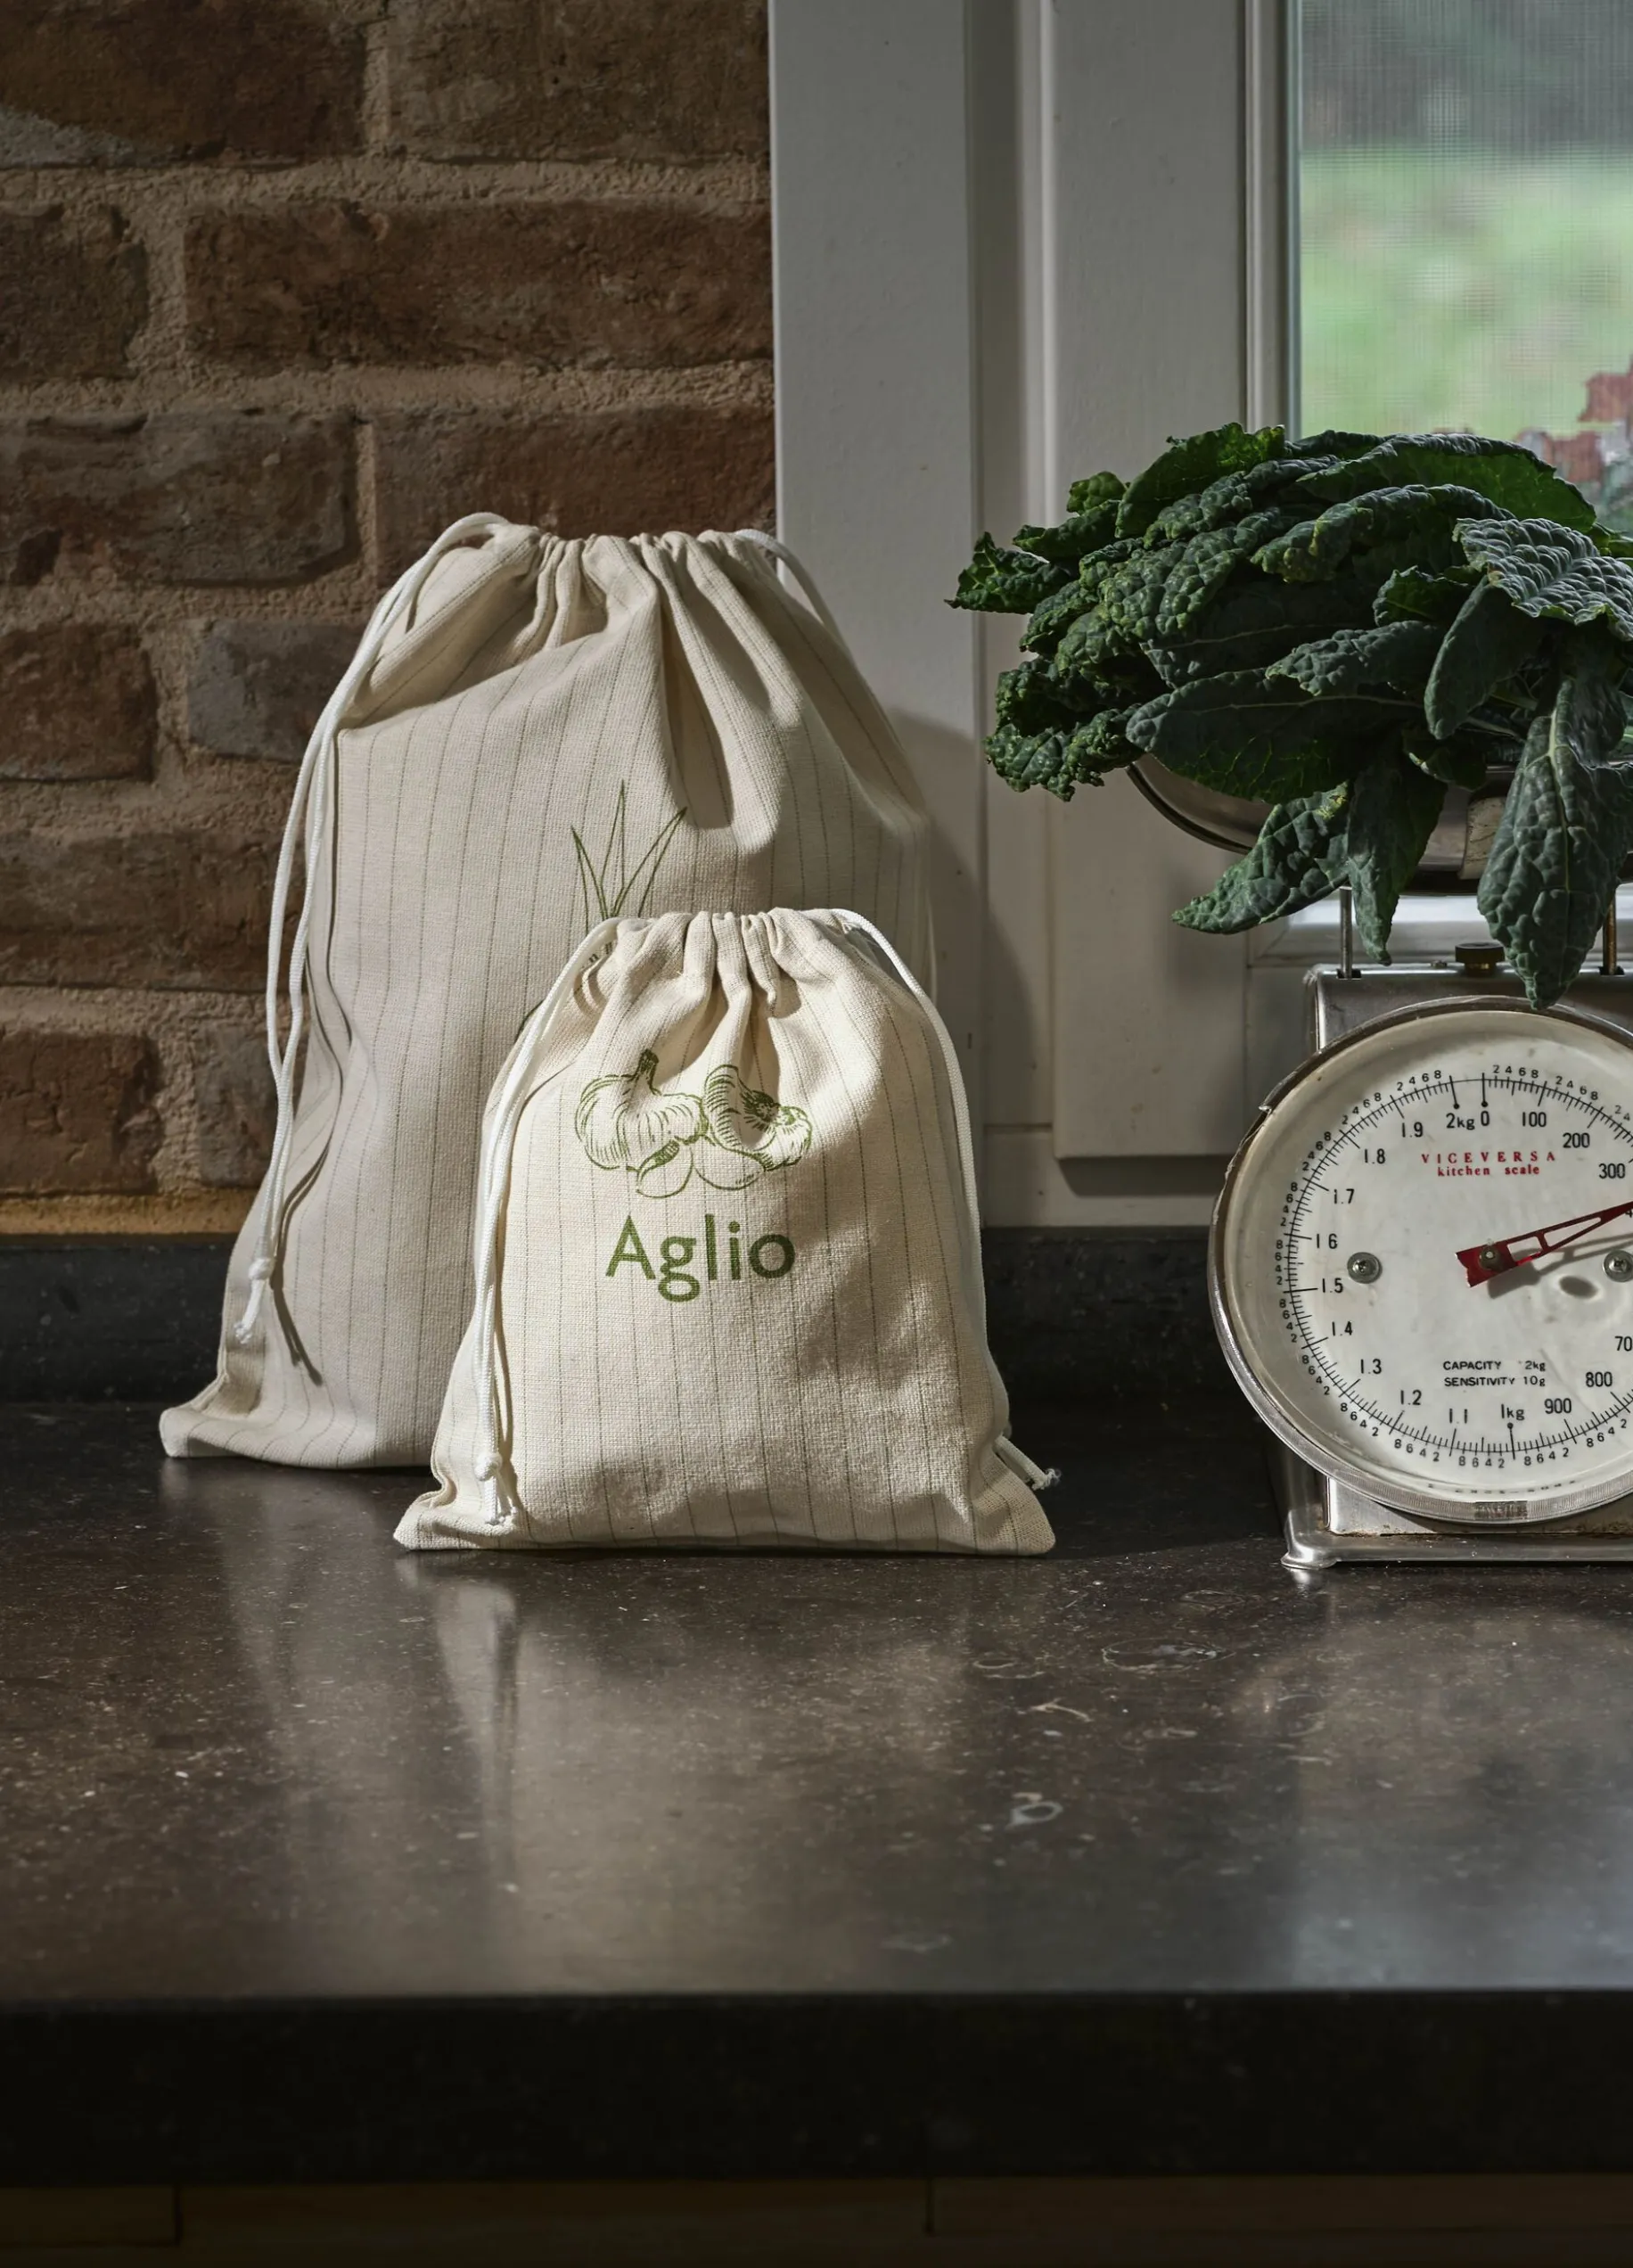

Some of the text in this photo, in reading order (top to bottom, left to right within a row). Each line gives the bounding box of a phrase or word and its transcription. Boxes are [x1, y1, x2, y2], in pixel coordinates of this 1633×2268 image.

[1493, 1064, 1539, 1079] 2 4 6 8
[1397, 1070, 1441, 1091] 2 4 6 8
[1555, 1075, 1598, 1100] 2 4 6 8
[1342, 1092, 1382, 1125] 2 4 6 8
[1614, 1105, 1630, 1122] 2 4
[1446, 1113, 1475, 1130] 2kg
[1481, 1110, 1490, 1127] 0
[1522, 1111, 1547, 1128] 100
[1401, 1122, 1424, 1138] 1.9
[1563, 1132, 1590, 1149] 200
[1302, 1131, 1332, 1171] 2 4 6 8
[1364, 1148, 1386, 1164] 1.8
[1421, 1151, 1555, 1164] VICEVERSA
[1437, 1163, 1539, 1177] kitchen scale
[1598, 1163, 1626, 1179] 300
[1280, 1182, 1298, 1227] 2 4 6 8
[1333, 1188, 1355, 1204] 1.7
[605, 1213, 796, 1302] Aglio
[1275, 1240, 1284, 1286] 2 4 6 8
[1322, 1278, 1343, 1294] 1.5
[1279, 1298, 1297, 1343] 2 4 6 8
[1332, 1320, 1353, 1336] 1.4
[1614, 1335, 1632, 1352] 70
[1301, 1354, 1330, 1395] 8 6 4 2
[1360, 1358, 1382, 1375] 1.3
[1442, 1360, 1546, 1372] CAPACITY 2kg
[1444, 1376, 1546, 1386] SENSITIVITY 10g
[1585, 1371, 1612, 1387] 800
[1400, 1389, 1422, 1406] 1.2
[1544, 1397, 1572, 1415] 900
[1340, 1402, 1379, 1437] 8 6 4 2
[1501, 1403, 1525, 1421] 1kg
[1586, 1418, 1628, 1448] 8 6 4 2
[1394, 1438, 1440, 1462] 8 6 4 2
[1524, 1447, 1570, 1467] 8 6 4 2
[1458, 1456, 1505, 1469] 8 6 4 2
